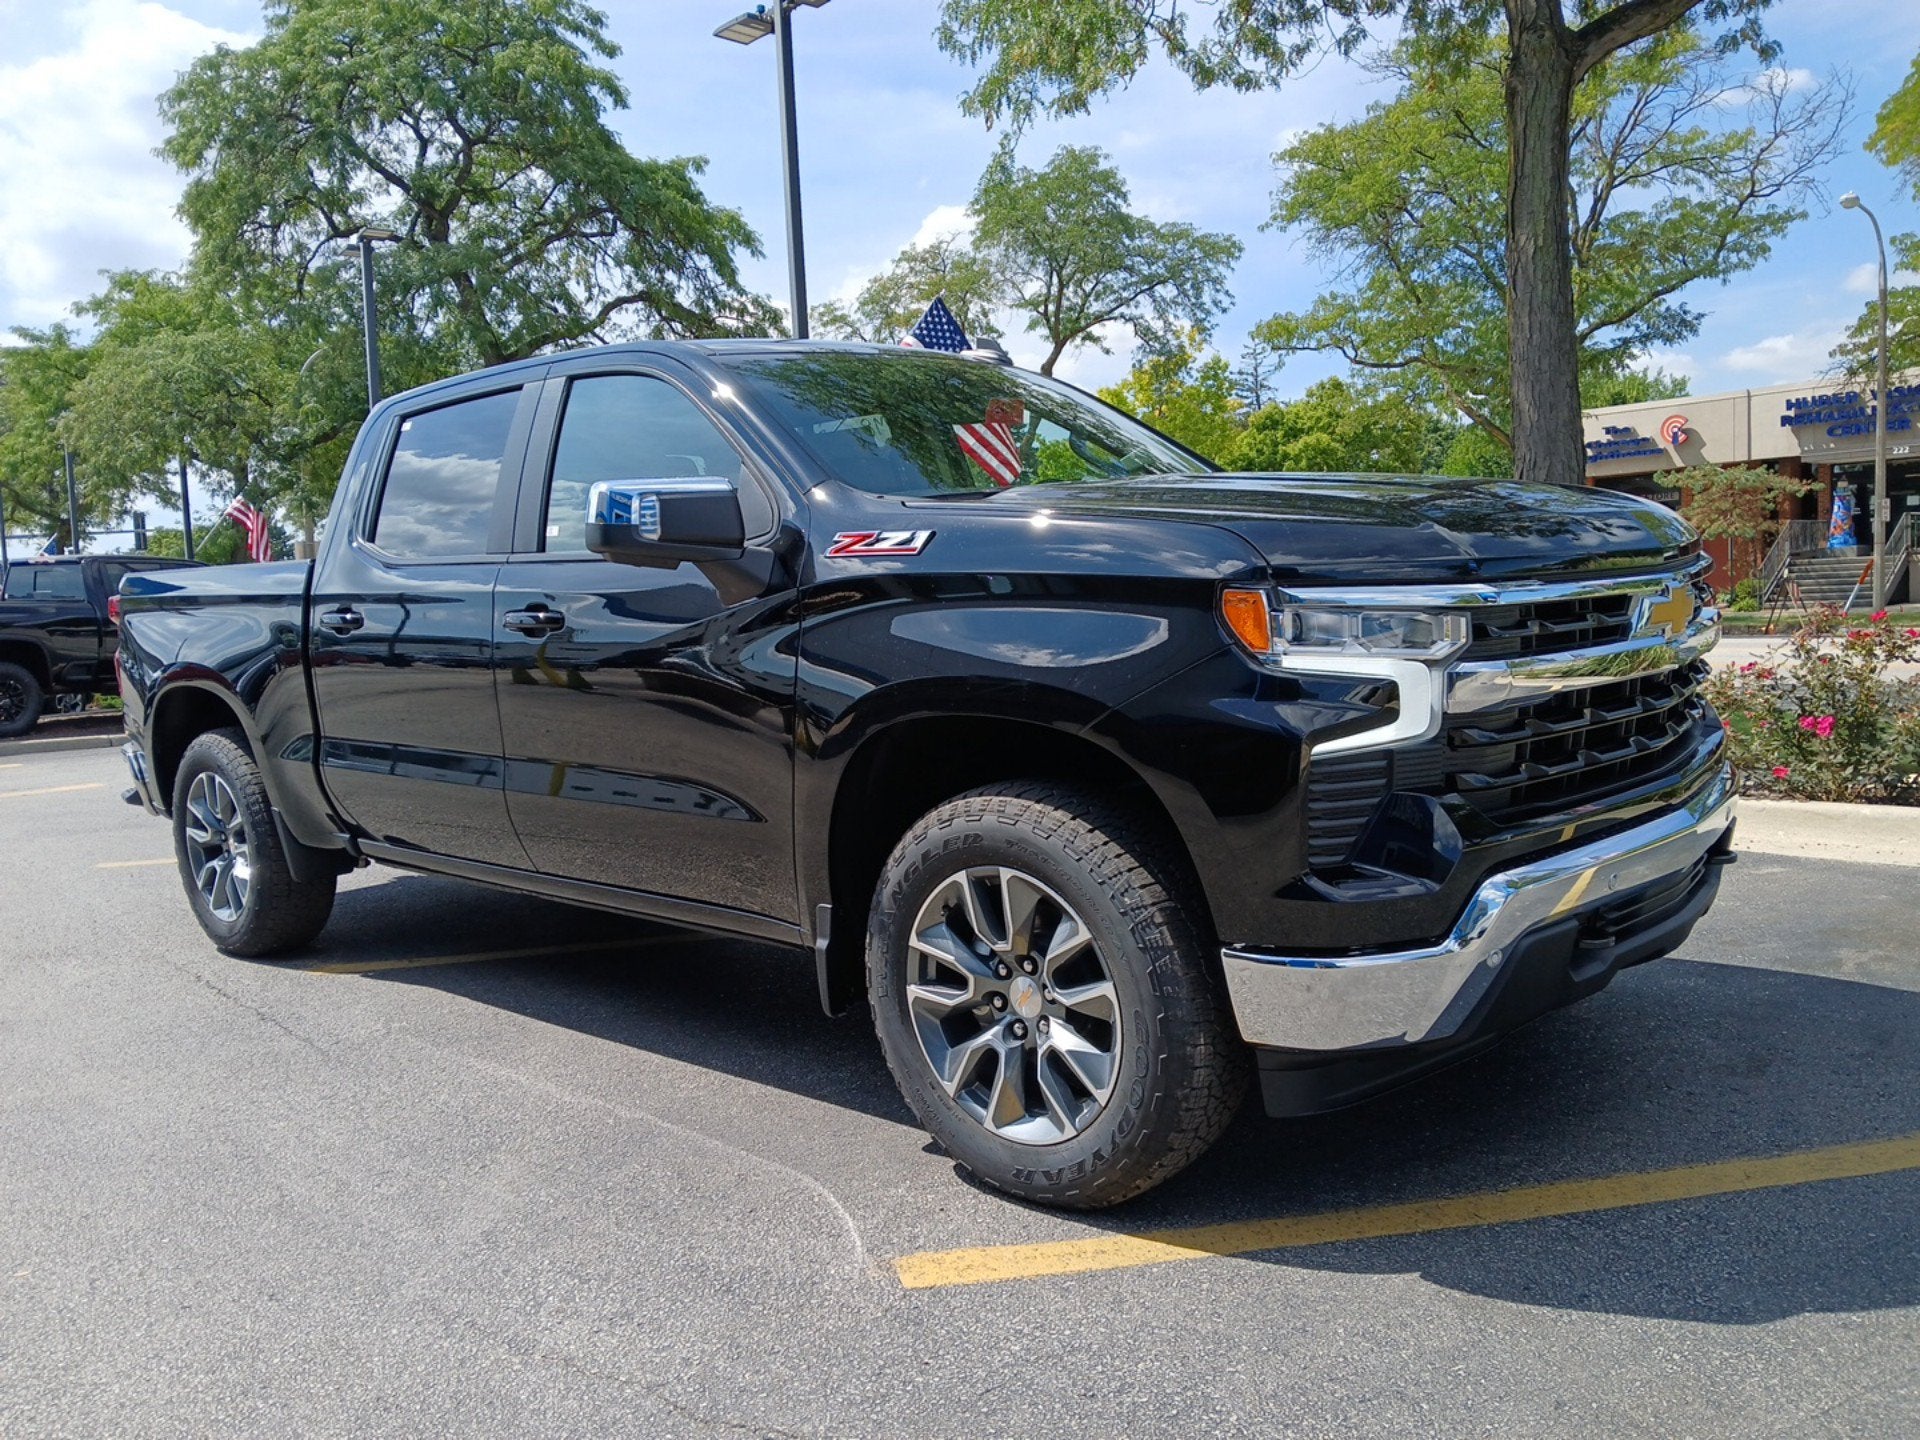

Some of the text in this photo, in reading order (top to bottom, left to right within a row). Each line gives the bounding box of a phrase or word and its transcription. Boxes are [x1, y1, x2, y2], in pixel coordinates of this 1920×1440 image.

[1892, 446, 1911, 455] 222
[823, 530, 937, 558] Z71
[1010, 1009, 1150, 1185] GOODYEAR
